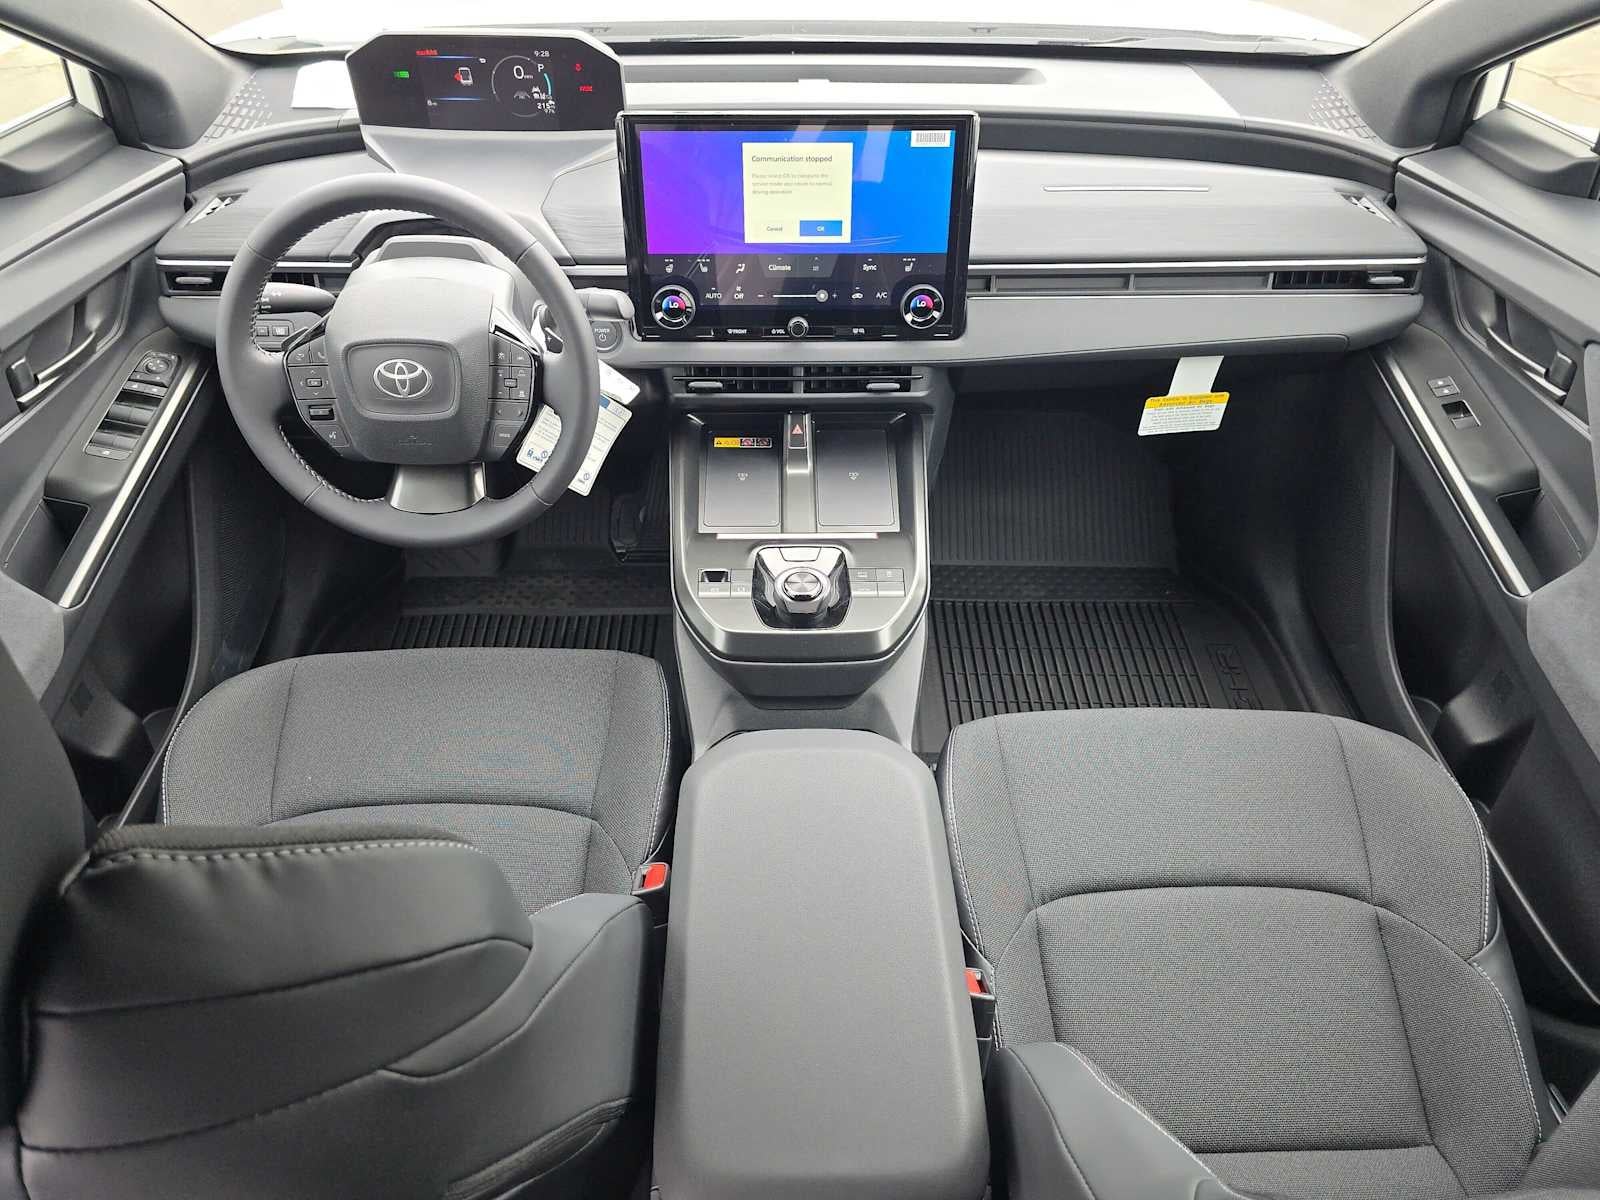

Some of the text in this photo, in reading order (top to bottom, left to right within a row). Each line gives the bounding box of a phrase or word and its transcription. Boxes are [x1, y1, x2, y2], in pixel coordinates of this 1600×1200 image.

[513, 65, 524, 79] 0
[537, 64, 544, 72] P
[805, 155, 833, 164] stopped
[862, 263, 877, 272] Sync
[876, 291, 888, 299] A/C
[669, 301, 679, 309] Lo
[916, 299, 926, 307] Lo
